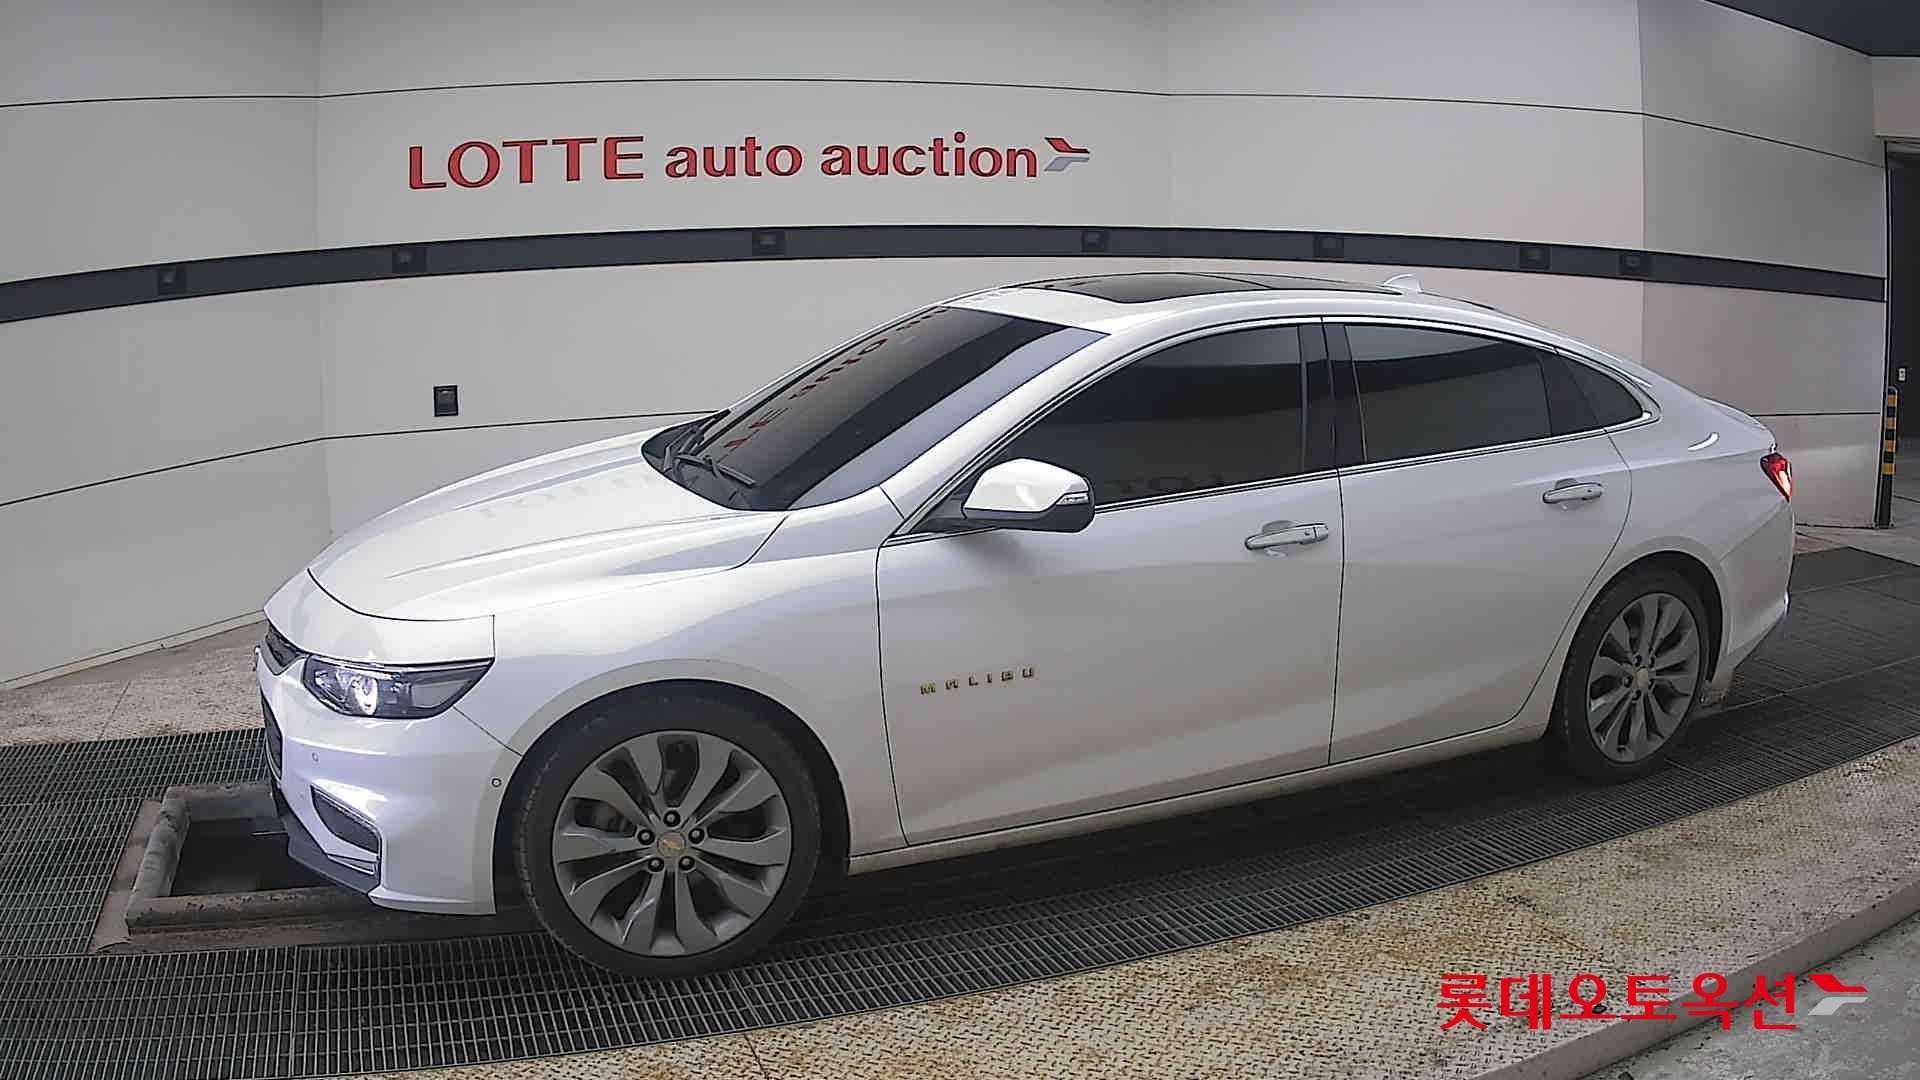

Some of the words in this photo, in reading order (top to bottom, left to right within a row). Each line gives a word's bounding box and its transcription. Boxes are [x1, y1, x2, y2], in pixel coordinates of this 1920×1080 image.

[408, 135, 645, 190] LOTTE
[665, 136, 803, 177] auto
[820, 132, 1038, 177] auction
[919, 667, 1035, 695] MALIBU
